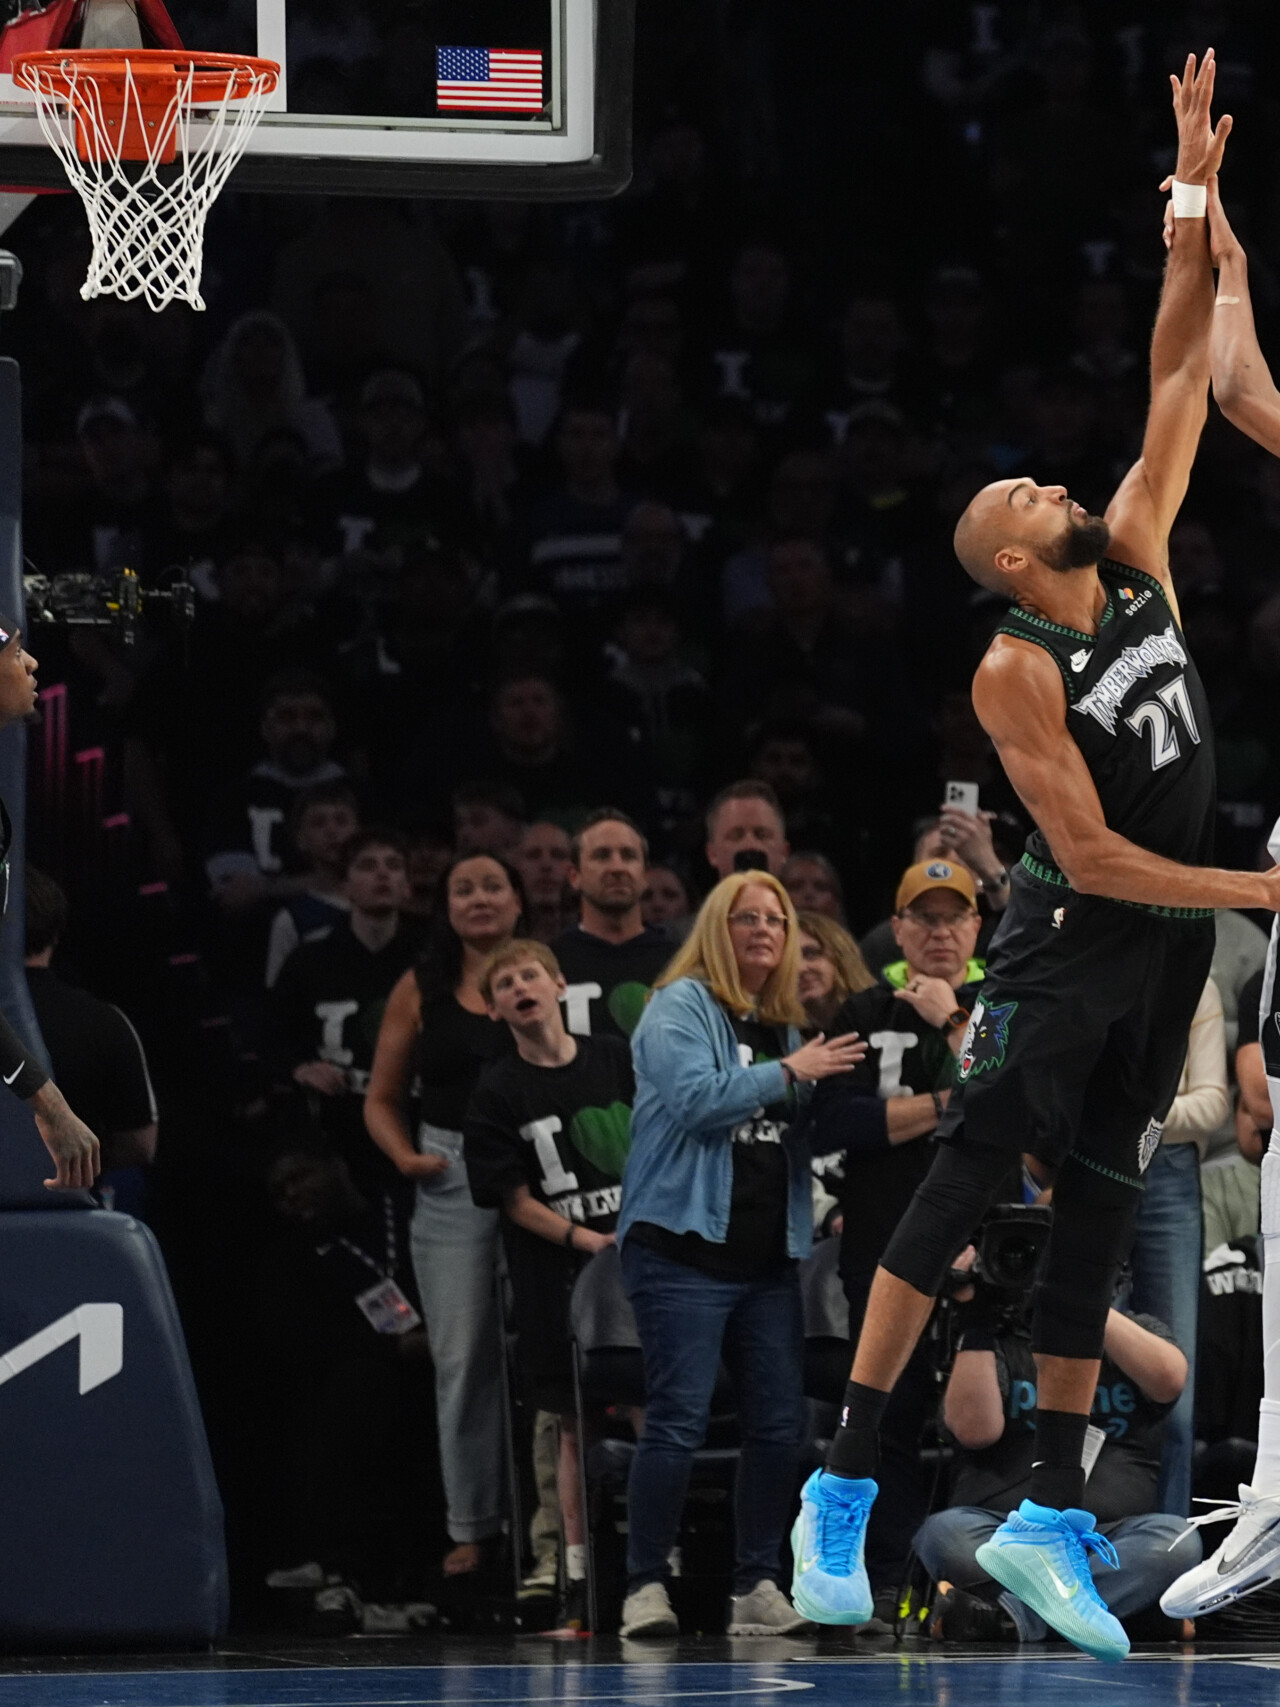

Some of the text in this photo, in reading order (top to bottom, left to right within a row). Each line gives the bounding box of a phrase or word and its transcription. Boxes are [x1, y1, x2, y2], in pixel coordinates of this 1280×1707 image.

[1125, 589, 1153, 617] sezzle
[1071, 620, 1188, 736] TIMBERWOLVES
[1124, 673, 1201, 771] 27
[869, 1030, 919, 1098] I
[519, 1114, 579, 1197] I
